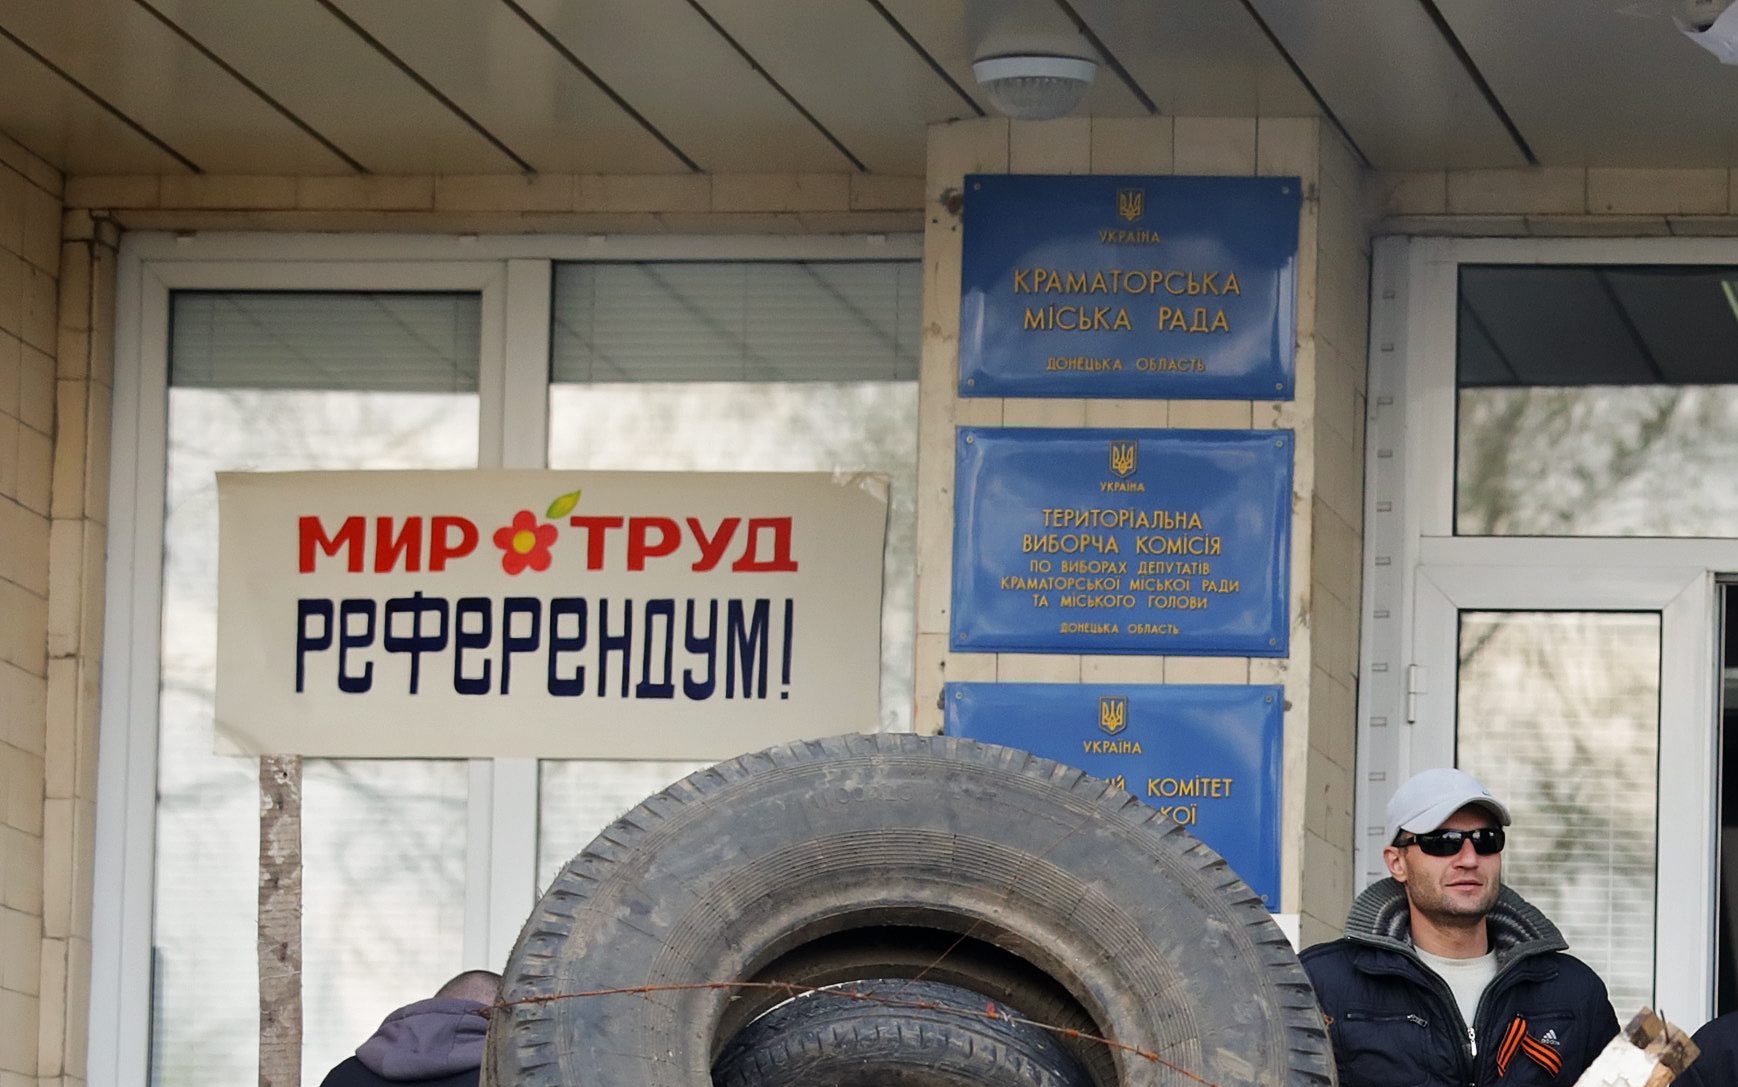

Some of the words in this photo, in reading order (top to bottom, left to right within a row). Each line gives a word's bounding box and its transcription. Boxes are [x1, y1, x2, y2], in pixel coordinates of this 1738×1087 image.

[1099, 231, 1161, 244] УКРАЇНА
[1014, 268, 1241, 296] КРАМАТОРСЬКА
[1023, 303, 1133, 331] МІСЬКА
[1158, 306, 1230, 334] РАДА
[1046, 356, 1123, 372] ДОНЕЦЬКА
[1136, 357, 1205, 372] ОБЛАСТЬ
[1100, 480, 1145, 493] УКРАЇНА
[1043, 508, 1202, 530] ТЕРИТОРІАЛЬНА
[298, 515, 480, 574] МИР
[570, 516, 798, 573] ТРУД
[1022, 533, 1120, 554] ВИБОРЧА
[1137, 533, 1221, 555] КОМІСІЯ
[1030, 560, 1051, 573] ПО
[1062, 560, 1127, 574] ВИБОРАХ
[1137, 561, 1210, 576] ДЕПУТАТІВ
[1001, 576, 1121, 591] КРАМАТОРСЬКОЇ
[1130, 578, 1190, 592] МІСЬКОЇ
[1202, 580, 1239, 593] РАДИ
[1032, 594, 1048, 607] ТА
[1060, 595, 1136, 609] МІСЬКОГО
[1149, 595, 1208, 610] ГОЛОВИ
[1059, 622, 1119, 635] ДОНЕЦЬКА
[1128, 623, 1179, 635] ОБЛАСТЬ
[1082, 740, 1141, 754] УКРАЇНА
[1148, 775, 1232, 797] КОМІТЕТ
